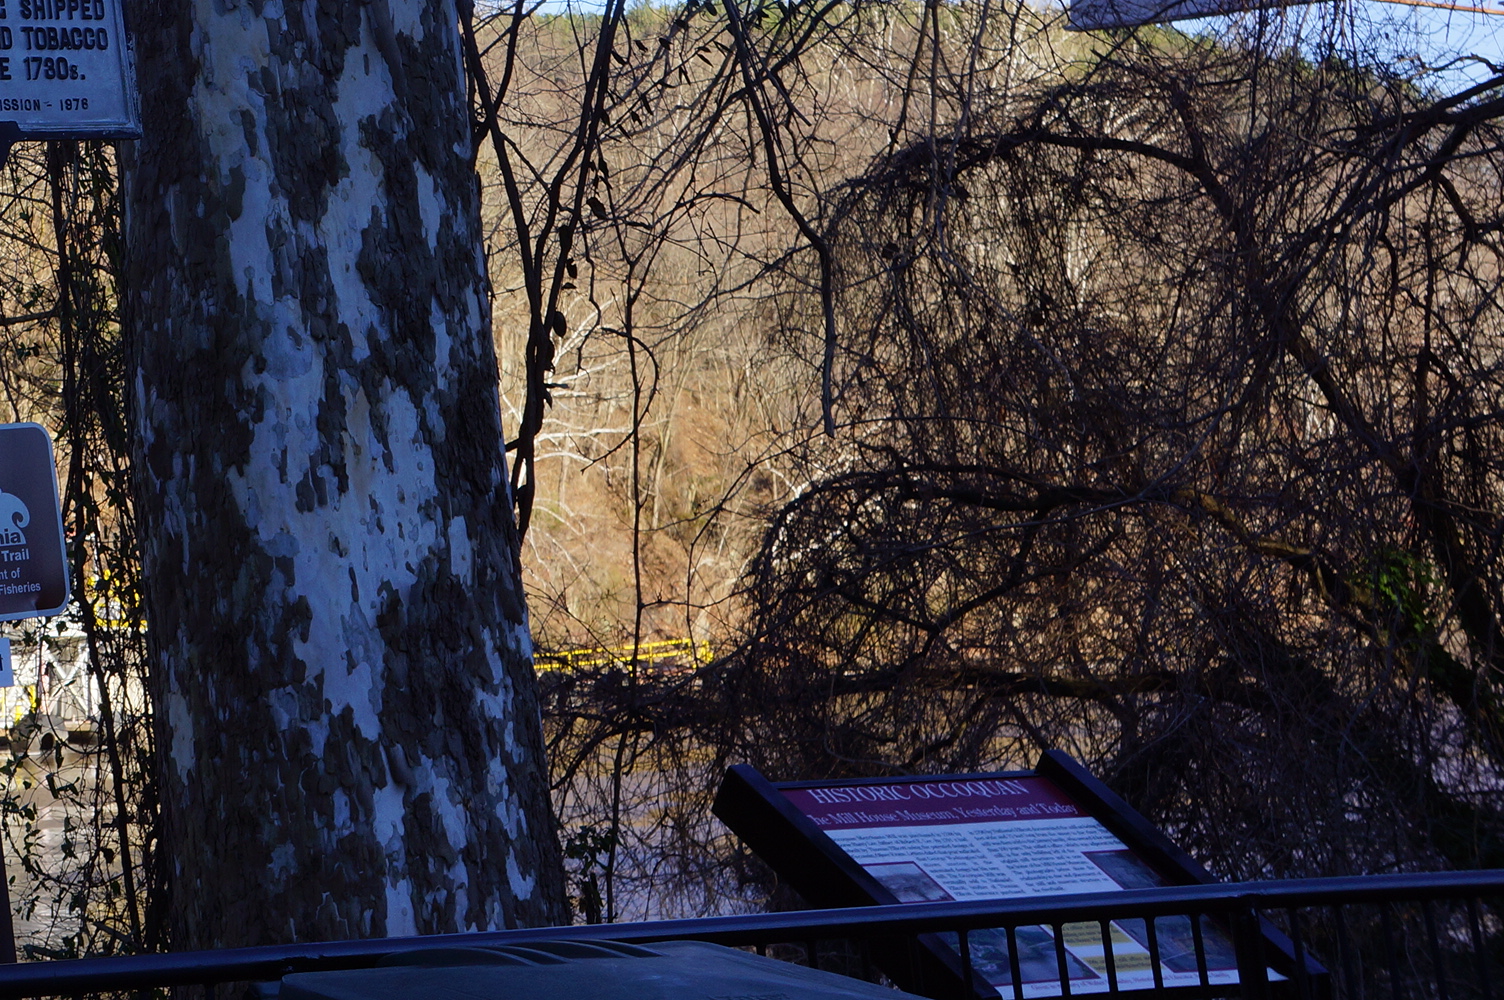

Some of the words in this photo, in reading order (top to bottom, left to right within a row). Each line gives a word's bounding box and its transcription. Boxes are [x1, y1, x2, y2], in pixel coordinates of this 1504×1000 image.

[20, 26, 109, 51] TOBACCO
[23, 56, 86, 81] 1730s.
[1, 548, 30, 562] Trail
[11, 567, 21, 579] of
[805, 784, 911, 804] HISTORIC
[909, 779, 1030, 799] OCCOQUAN
[806, 814, 832, 826] he
[827, 811, 858, 825] Mill
[854, 810, 900, 823] House
[895, 808, 959, 822] Museum,
[953, 804, 1017, 818] Yesterday
[1016, 803, 1042, 815] and
[1035, 801, 1078, 815] Today
